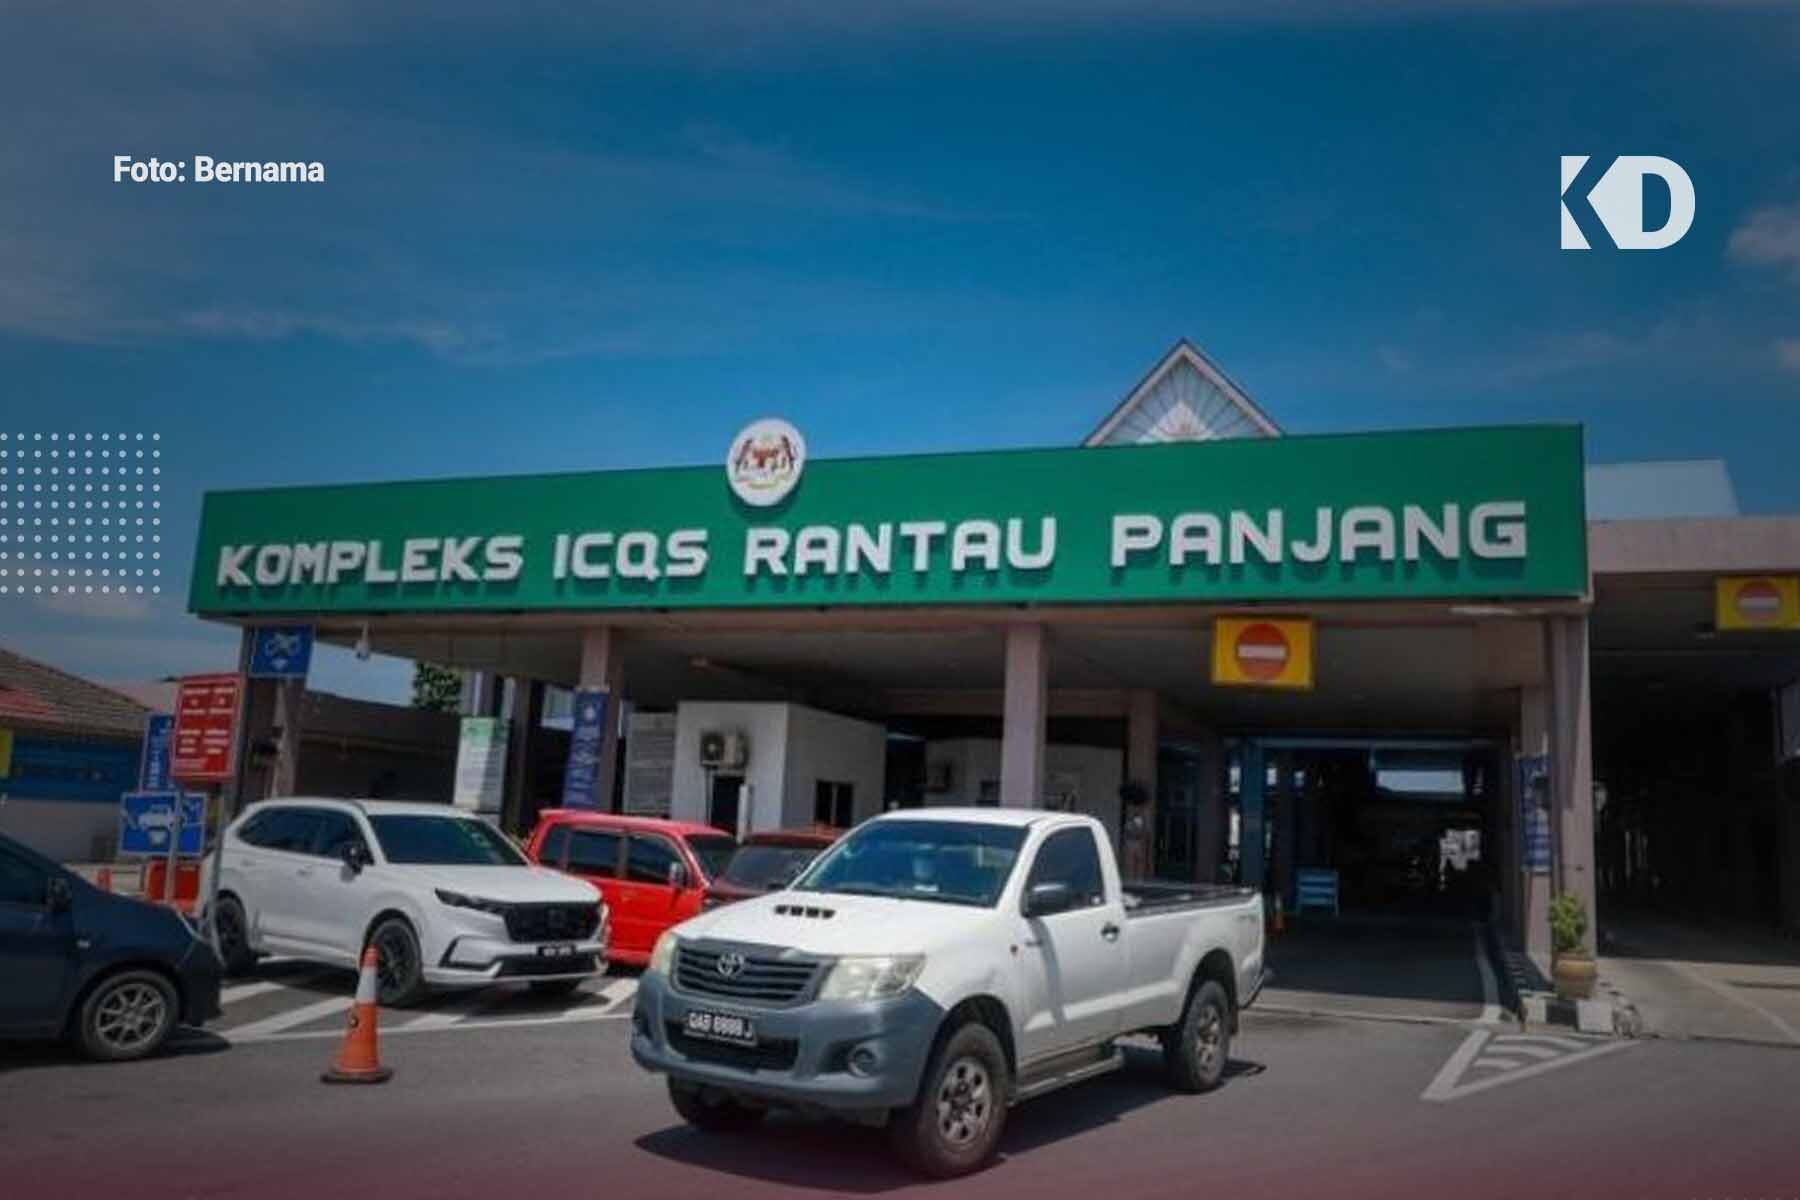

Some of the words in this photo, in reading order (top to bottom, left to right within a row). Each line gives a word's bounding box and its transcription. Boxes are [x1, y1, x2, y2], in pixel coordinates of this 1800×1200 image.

[216, 535, 524, 587] KOMPLEKS
[553, 529, 709, 581] ICQS
[743, 517, 1057, 576] RANTAU
[1111, 501, 1526, 567] PANJANG
